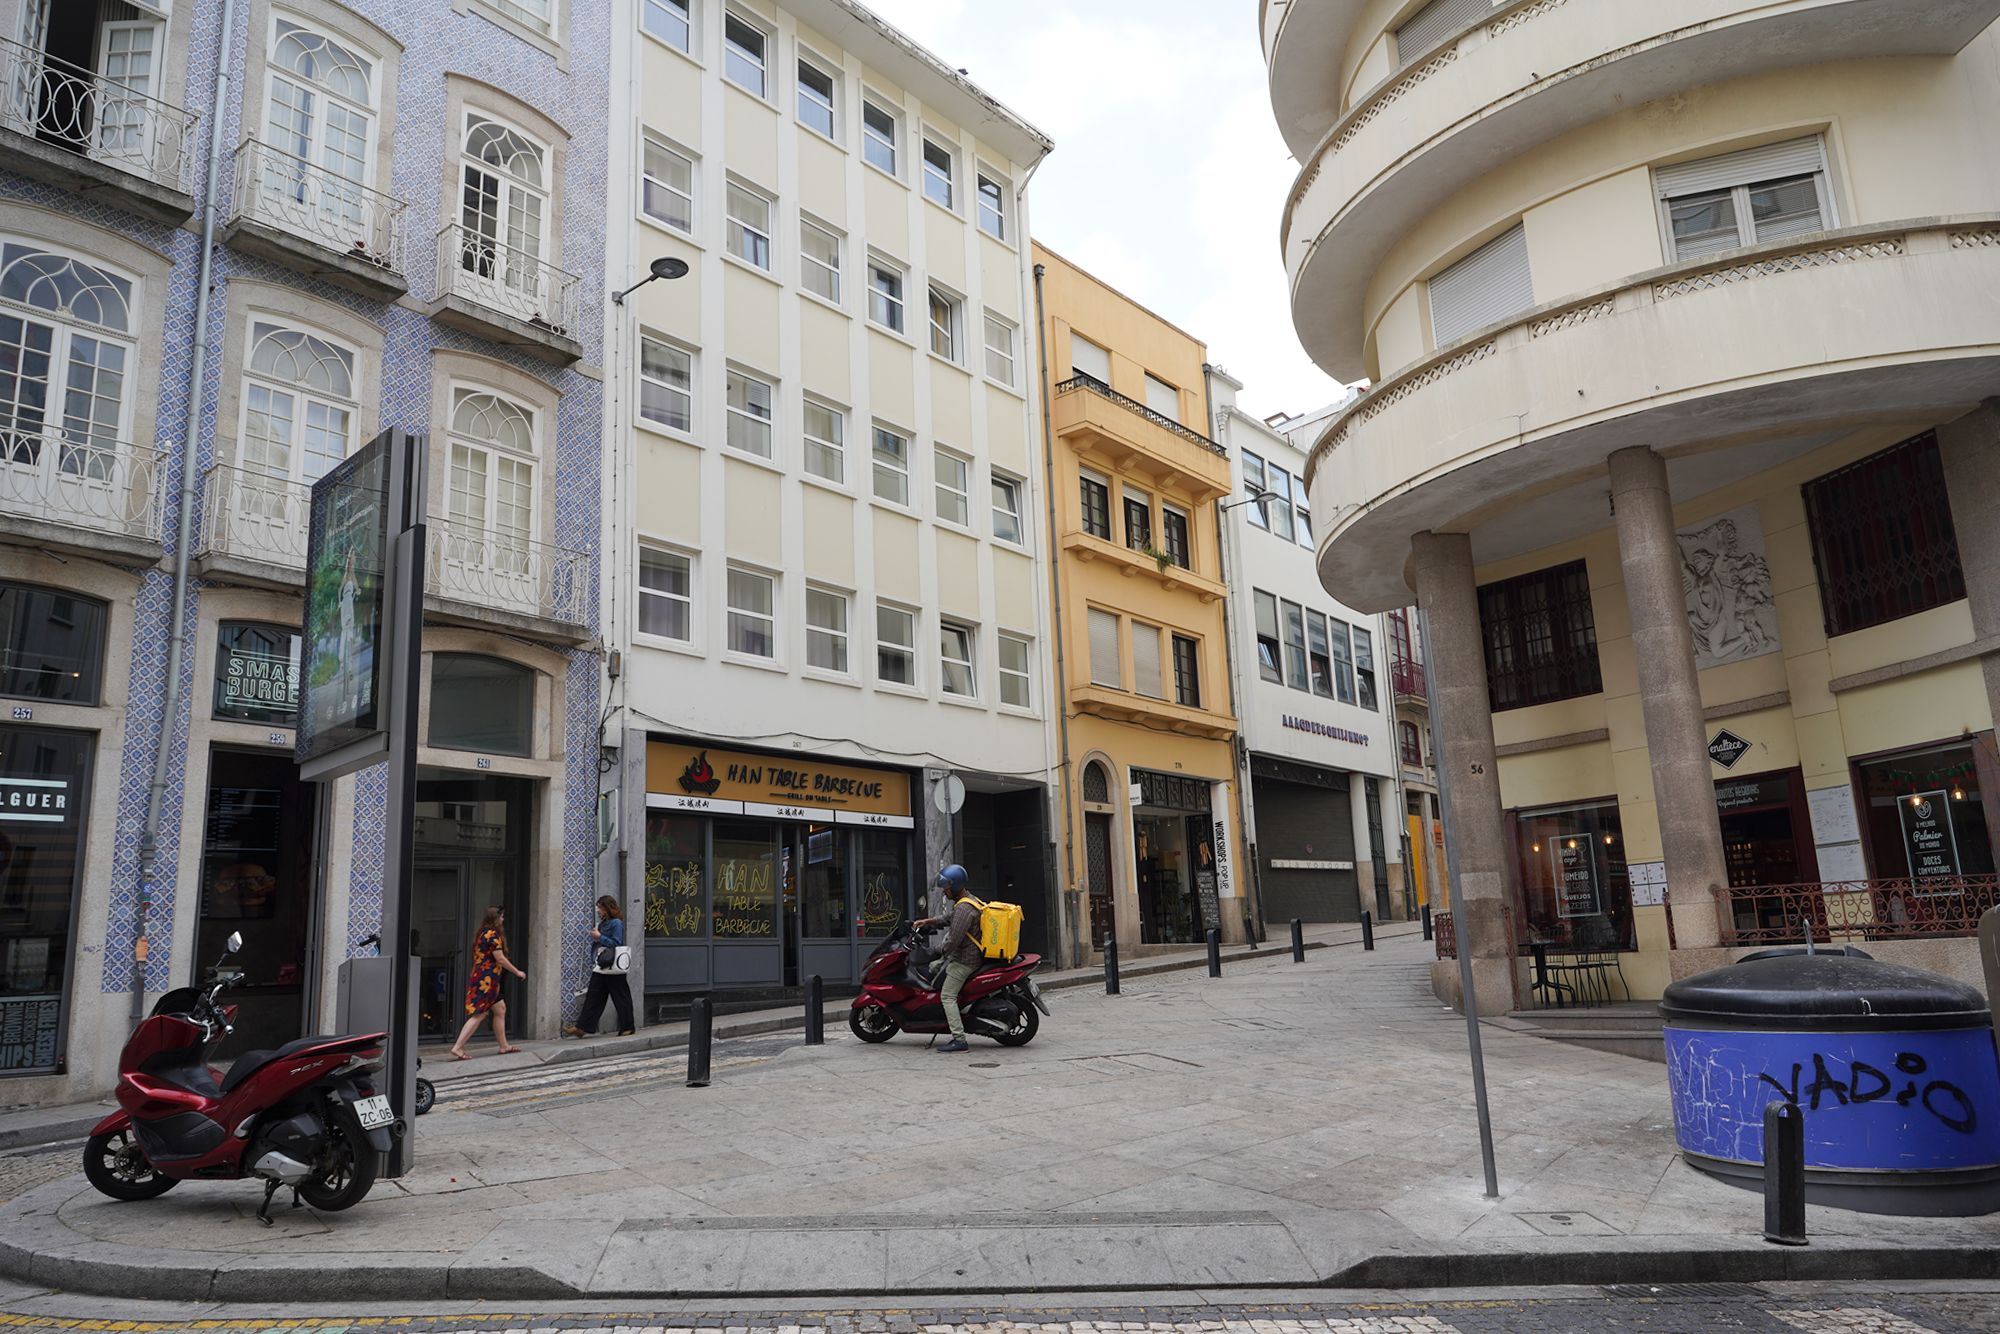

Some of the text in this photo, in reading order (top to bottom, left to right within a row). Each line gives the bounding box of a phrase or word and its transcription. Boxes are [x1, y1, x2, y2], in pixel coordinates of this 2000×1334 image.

[14, 708, 32, 719] 257
[1709, 738, 1743, 754] enaltece
[1470, 764, 1483, 774] 56
[727, 764, 883, 798] HAN TABLE BARBECUE
[815, 795, 831, 803] TABLE
[1215, 821, 1226, 863] WORKSHOPS
[1922, 855, 1942, 866] DOCES
[717, 863, 770, 893] HAN
[727, 896, 761, 911] TABLE
[715, 918, 771, 934] BARBECUE
[3, 1002, 24, 1045] BROWNIE
